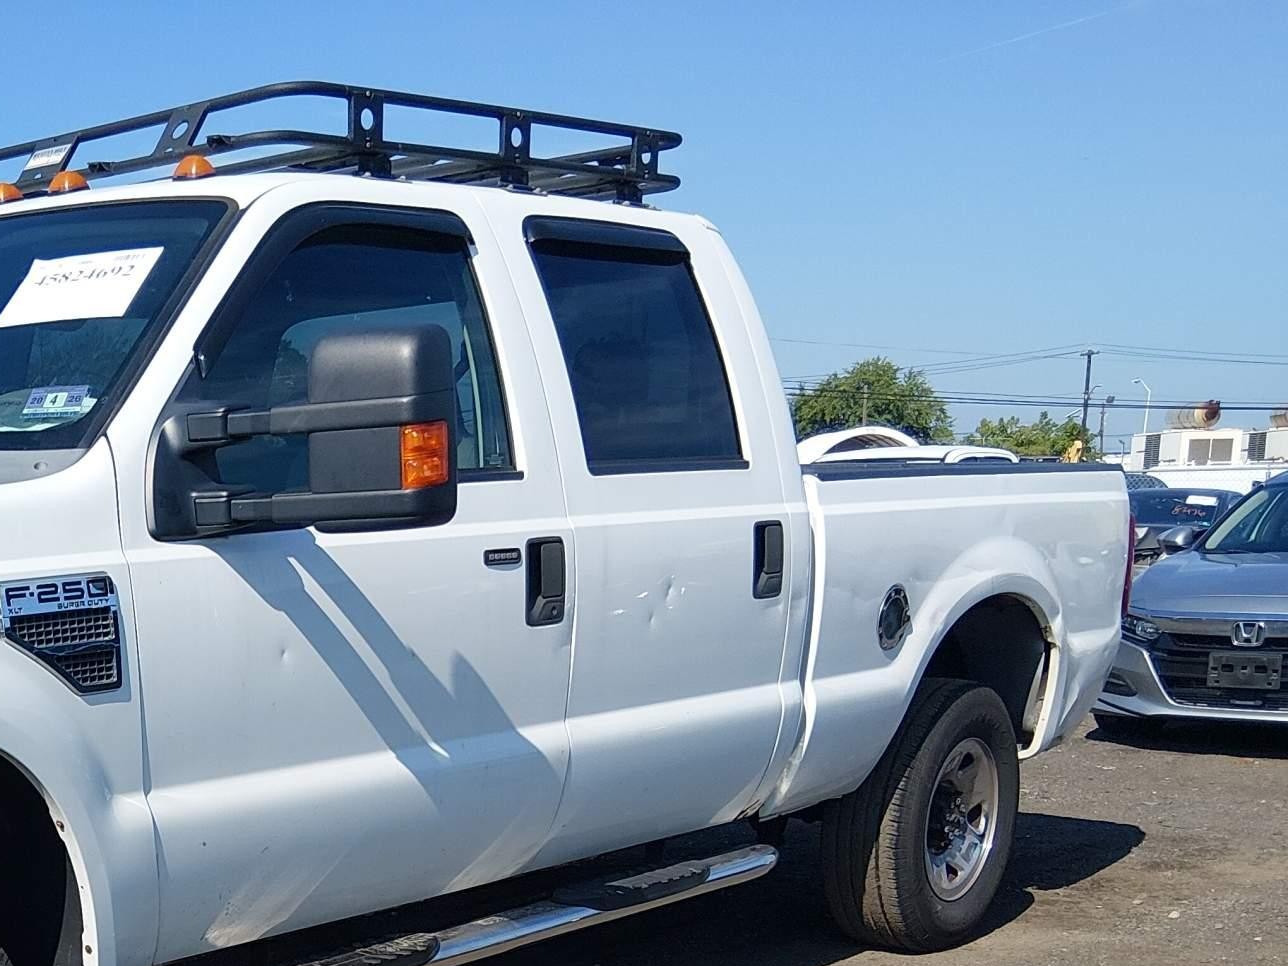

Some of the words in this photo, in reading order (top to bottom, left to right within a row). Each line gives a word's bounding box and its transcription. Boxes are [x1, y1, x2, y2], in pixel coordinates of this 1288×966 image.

[34, 264, 135, 287] 45824692
[49, 394, 59, 406] 4
[88, 598, 110, 607] DUTY
[8, 607, 23, 615] XLT
